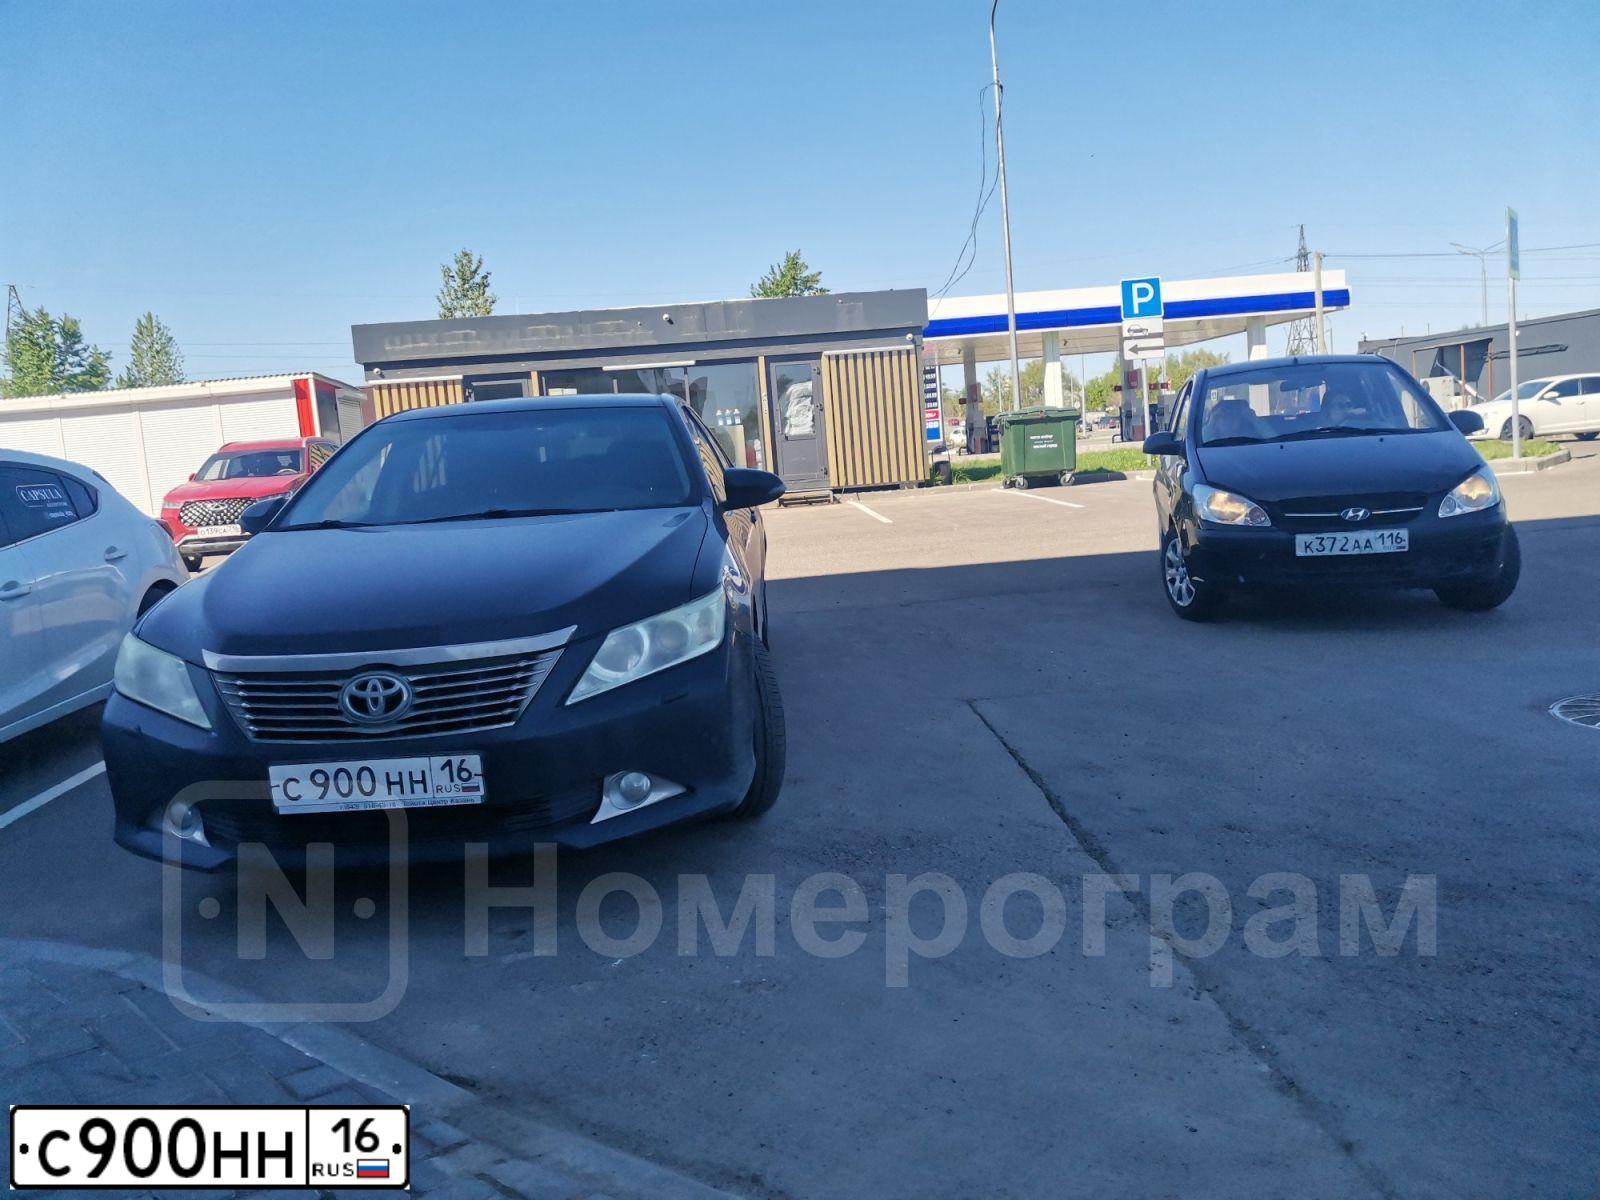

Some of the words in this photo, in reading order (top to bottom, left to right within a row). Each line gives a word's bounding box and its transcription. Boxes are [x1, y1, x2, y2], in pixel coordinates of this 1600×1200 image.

[1132, 282, 1155, 315] P
[20, 488, 63, 502] CAPSULA
[1304, 536, 1374, 554] К372АА
[1378, 531, 1403, 546] 116
[440, 758, 473, 784] 16
[435, 783, 461, 794] RUS
